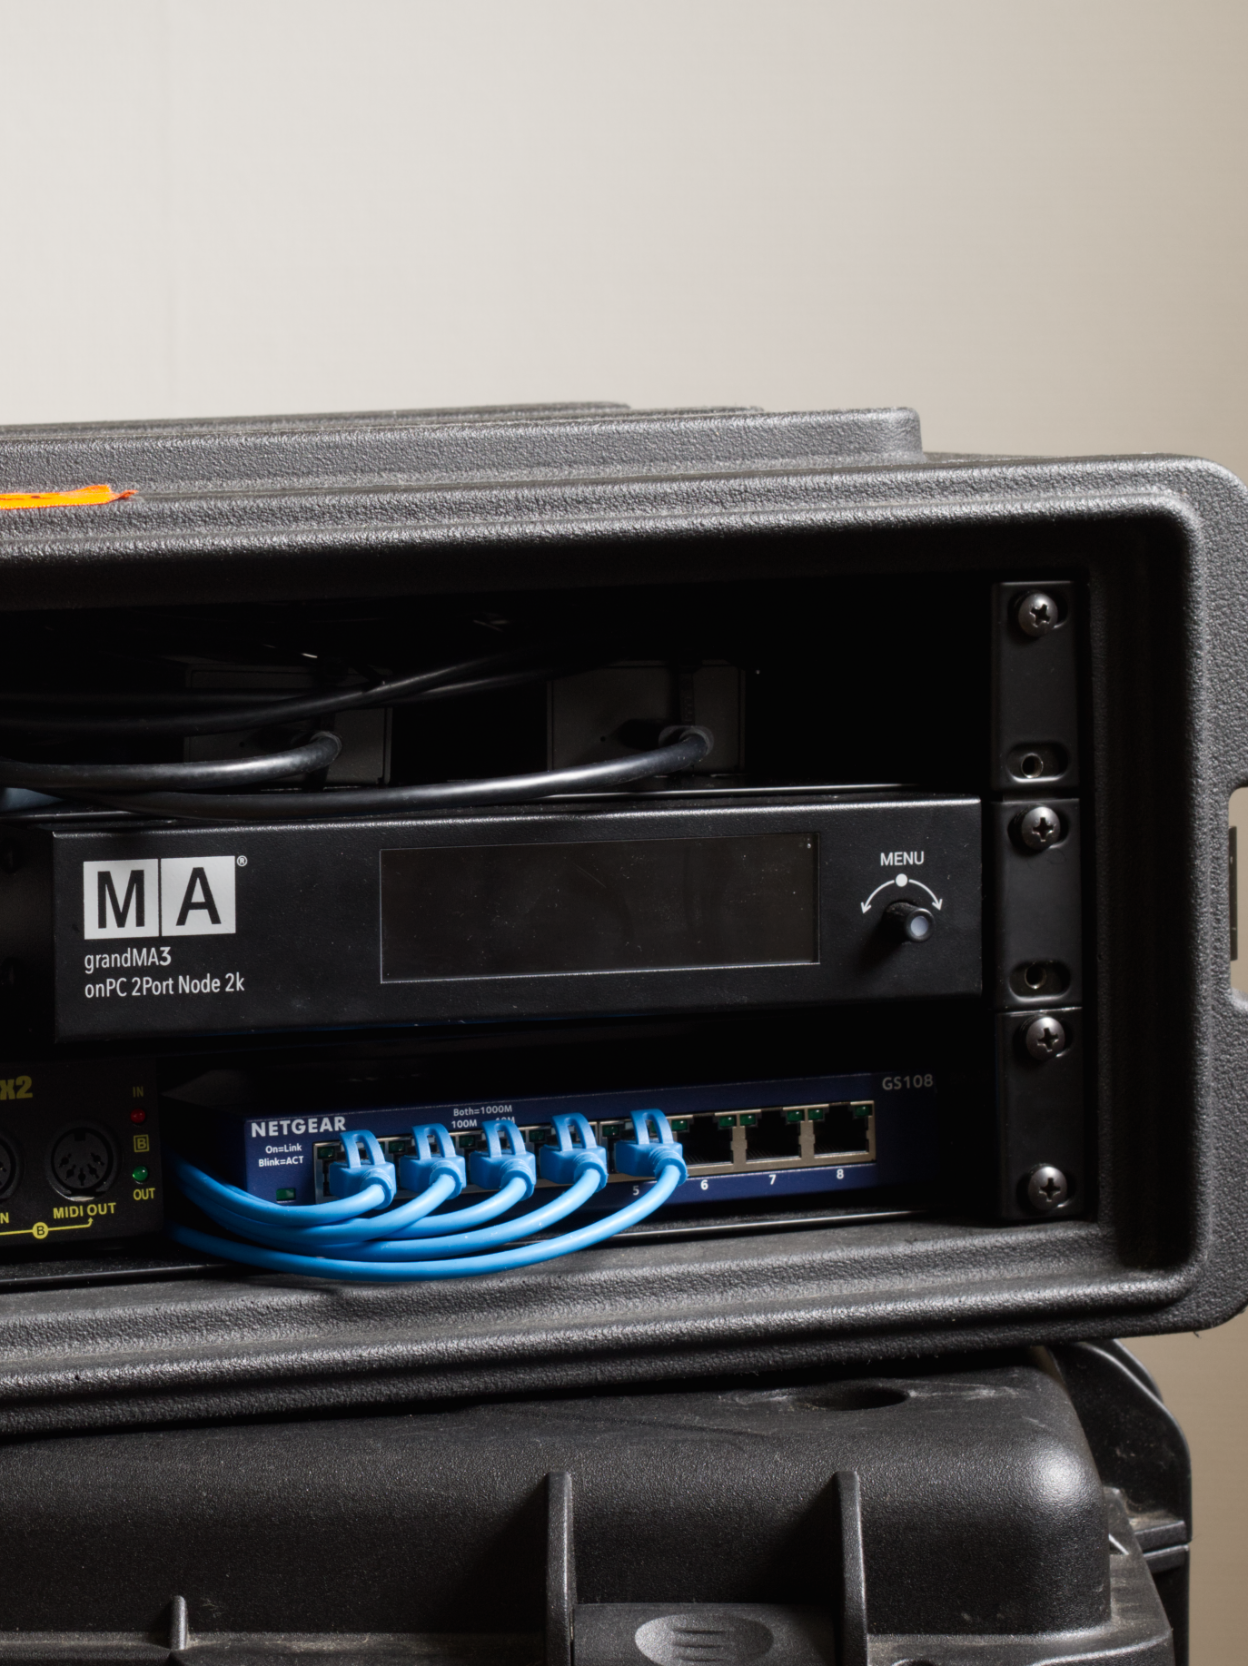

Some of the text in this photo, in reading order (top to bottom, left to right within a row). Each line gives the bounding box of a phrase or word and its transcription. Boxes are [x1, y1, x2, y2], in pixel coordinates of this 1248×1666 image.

[880, 851, 925, 866] MENU
[84, 946, 172, 975] grandMA3
[84, 971, 245, 998] onPC 2Port Node 2k
[881, 1073, 934, 1091] GS108
[132, 1086, 145, 1098] IN
[453, 1104, 513, 1117] Both=1000M
[251, 1116, 347, 1138] NETGEAR
[451, 1118, 478, 1129] 100M
[137, 1137, 147, 1149] B
[265, 1142, 302, 1155] On=Link
[258, 1155, 304, 1168] Blink=ACT
[768, 1174, 776, 1185] 7
[836, 1168, 844, 1180] 8
[632, 1185, 640, 1196] 5
[700, 1179, 709, 1191] 6
[133, 1187, 156, 1201] OUT
[52, 1202, 117, 1219] MIDI OUT
[37, 1225, 45, 1236] B
